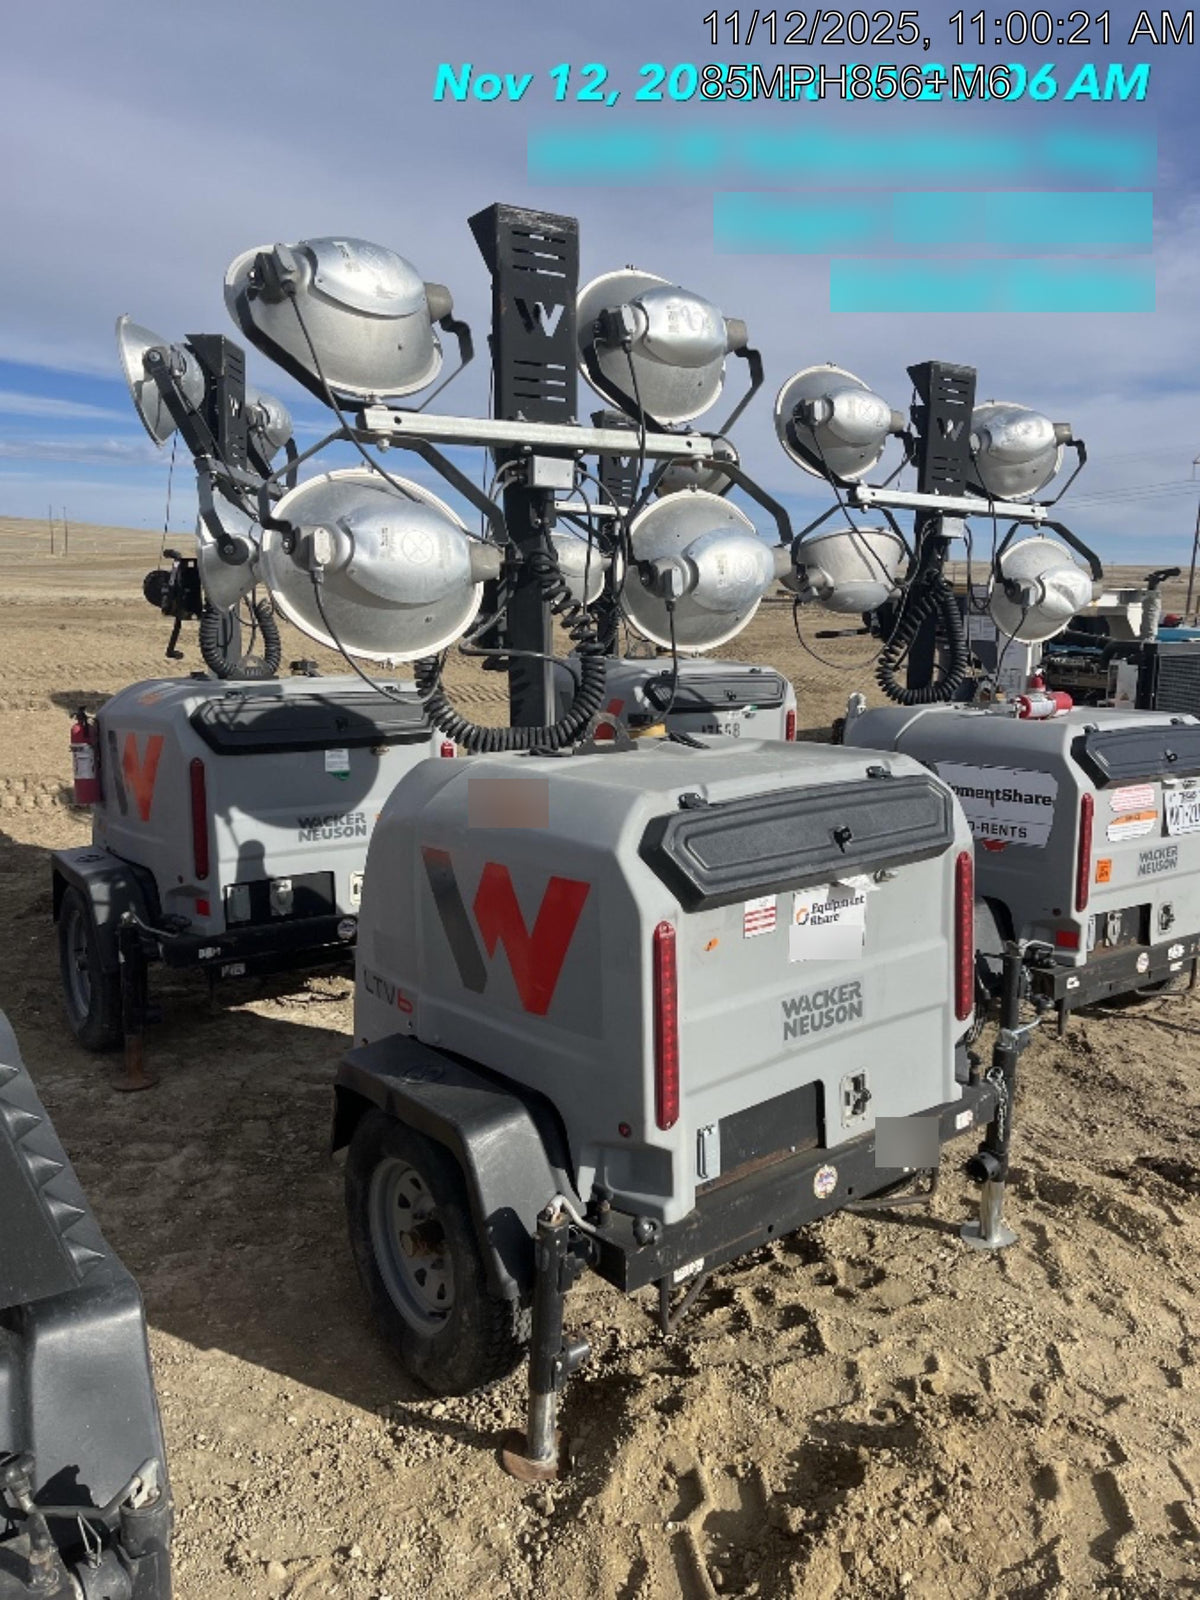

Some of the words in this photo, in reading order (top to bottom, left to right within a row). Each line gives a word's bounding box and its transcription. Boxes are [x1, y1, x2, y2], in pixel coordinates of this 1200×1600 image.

[297, 812, 367, 836] WACKER
[298, 823, 367, 844] NEUSON
[781, 980, 863, 1020] WACKER
[783, 999, 864, 1041] NEUSON
